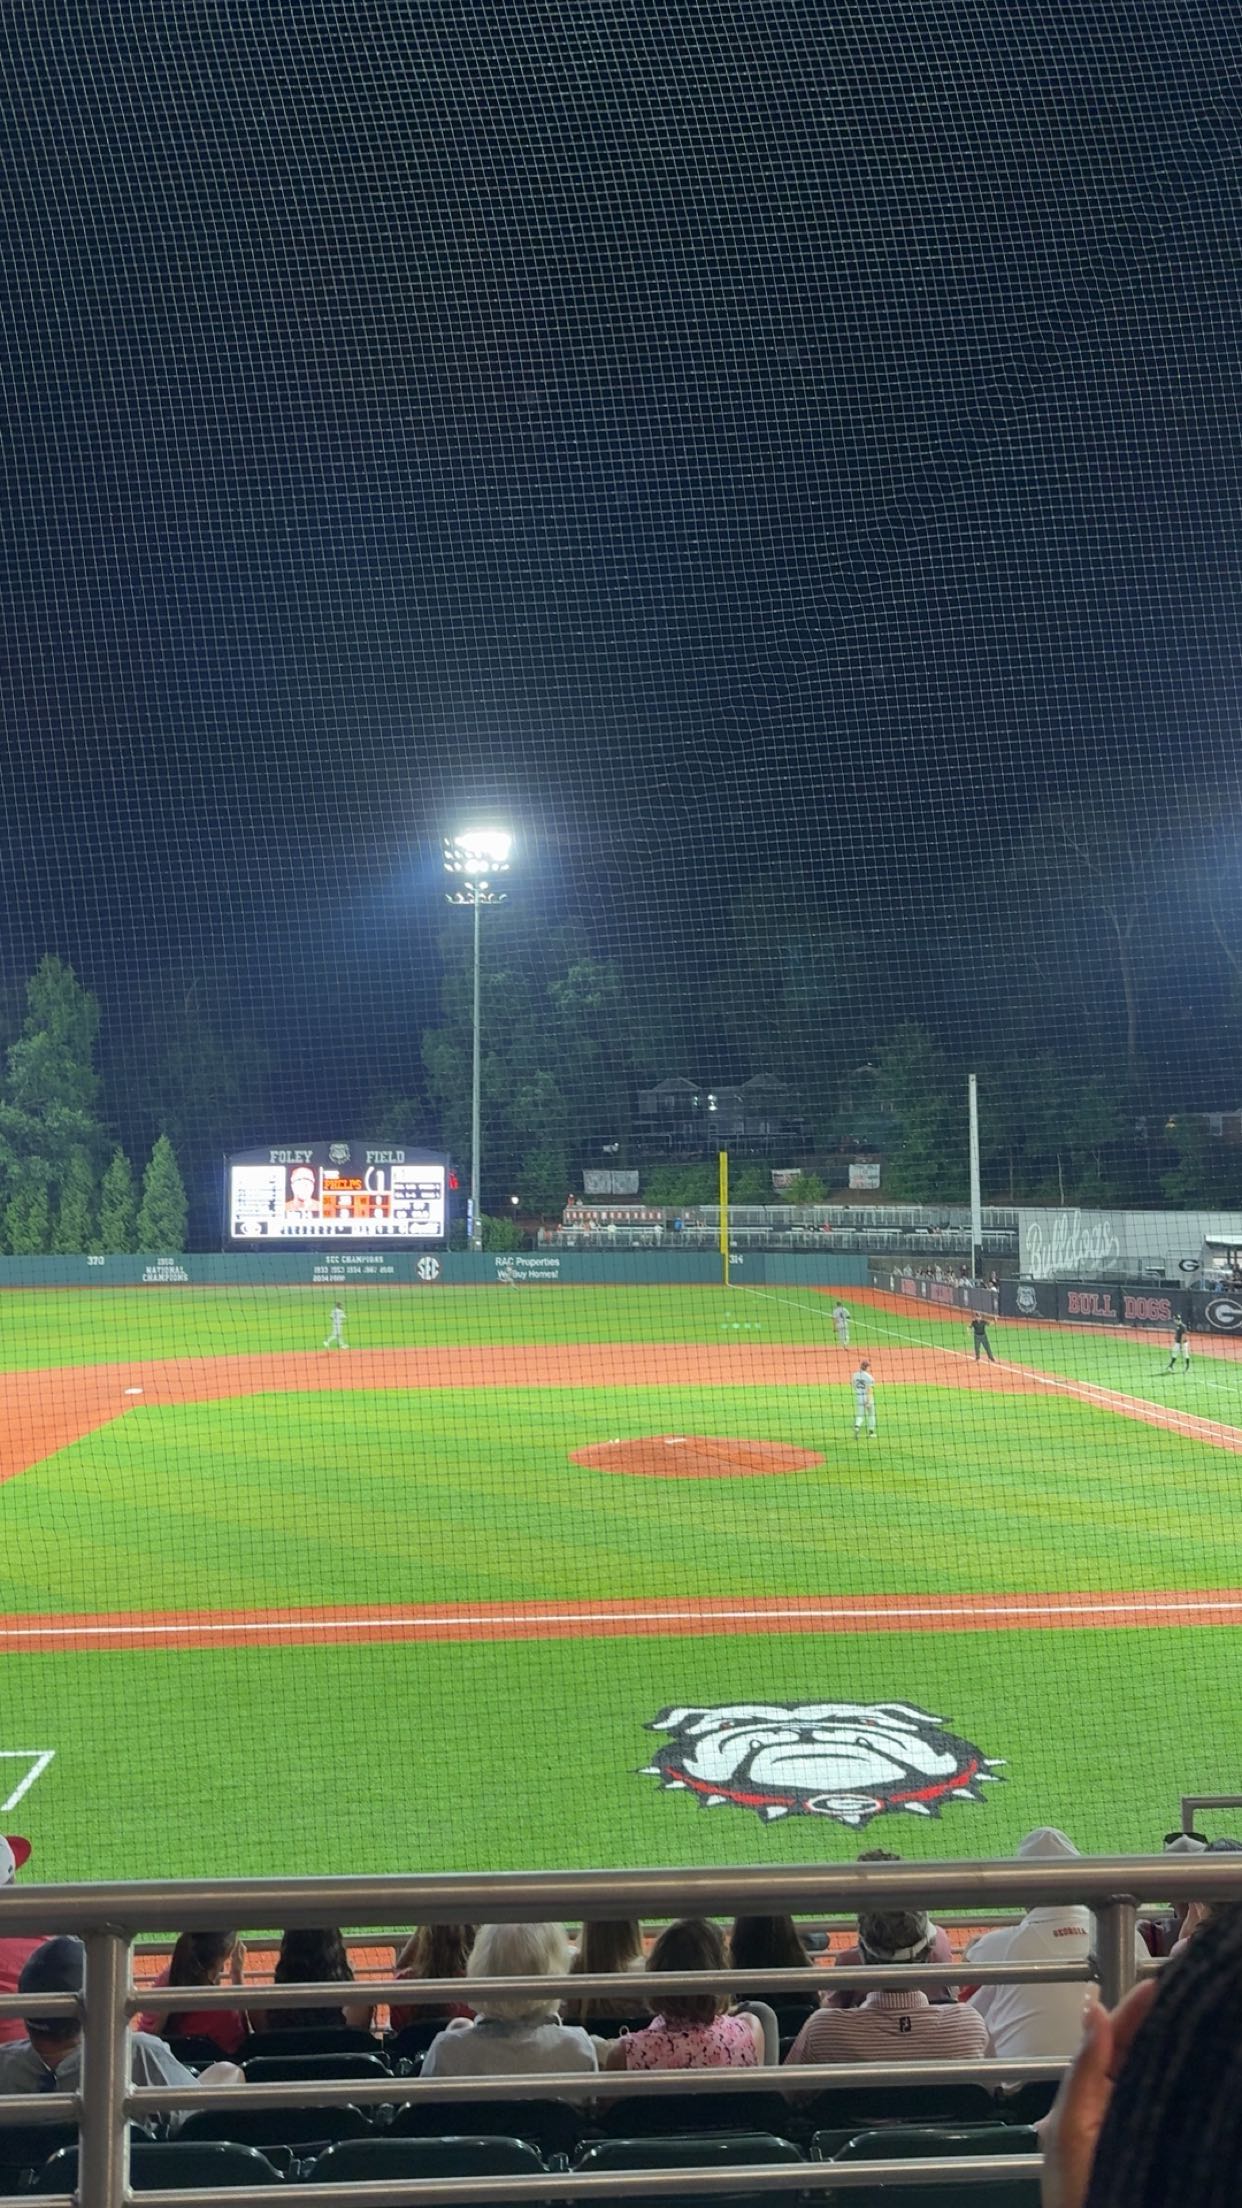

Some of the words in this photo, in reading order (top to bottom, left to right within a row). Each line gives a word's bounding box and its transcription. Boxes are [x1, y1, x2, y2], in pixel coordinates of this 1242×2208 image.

[269, 1150, 313, 1164] FOLEY
[366, 1150, 405, 1164] FIELD
[323, 1179, 362, 1190] PHELPS
[1026, 1210, 1119, 1280] Bulldogs
[87, 1256, 105, 1266] 370
[326, 1256, 340, 1264] SEC
[341, 1255, 384, 1264] CHAMPIONS
[495, 1257, 514, 1267] RAC
[515, 1257, 560, 1268] Properties
[145, 1266, 184, 1274] NATIONAL
[417, 1256, 440, 1280] SEC
[142, 1273, 189, 1282] CHAMPIONS
[1067, 1291, 1117, 1318] BULL
[1124, 1296, 1172, 1321] DOGS
